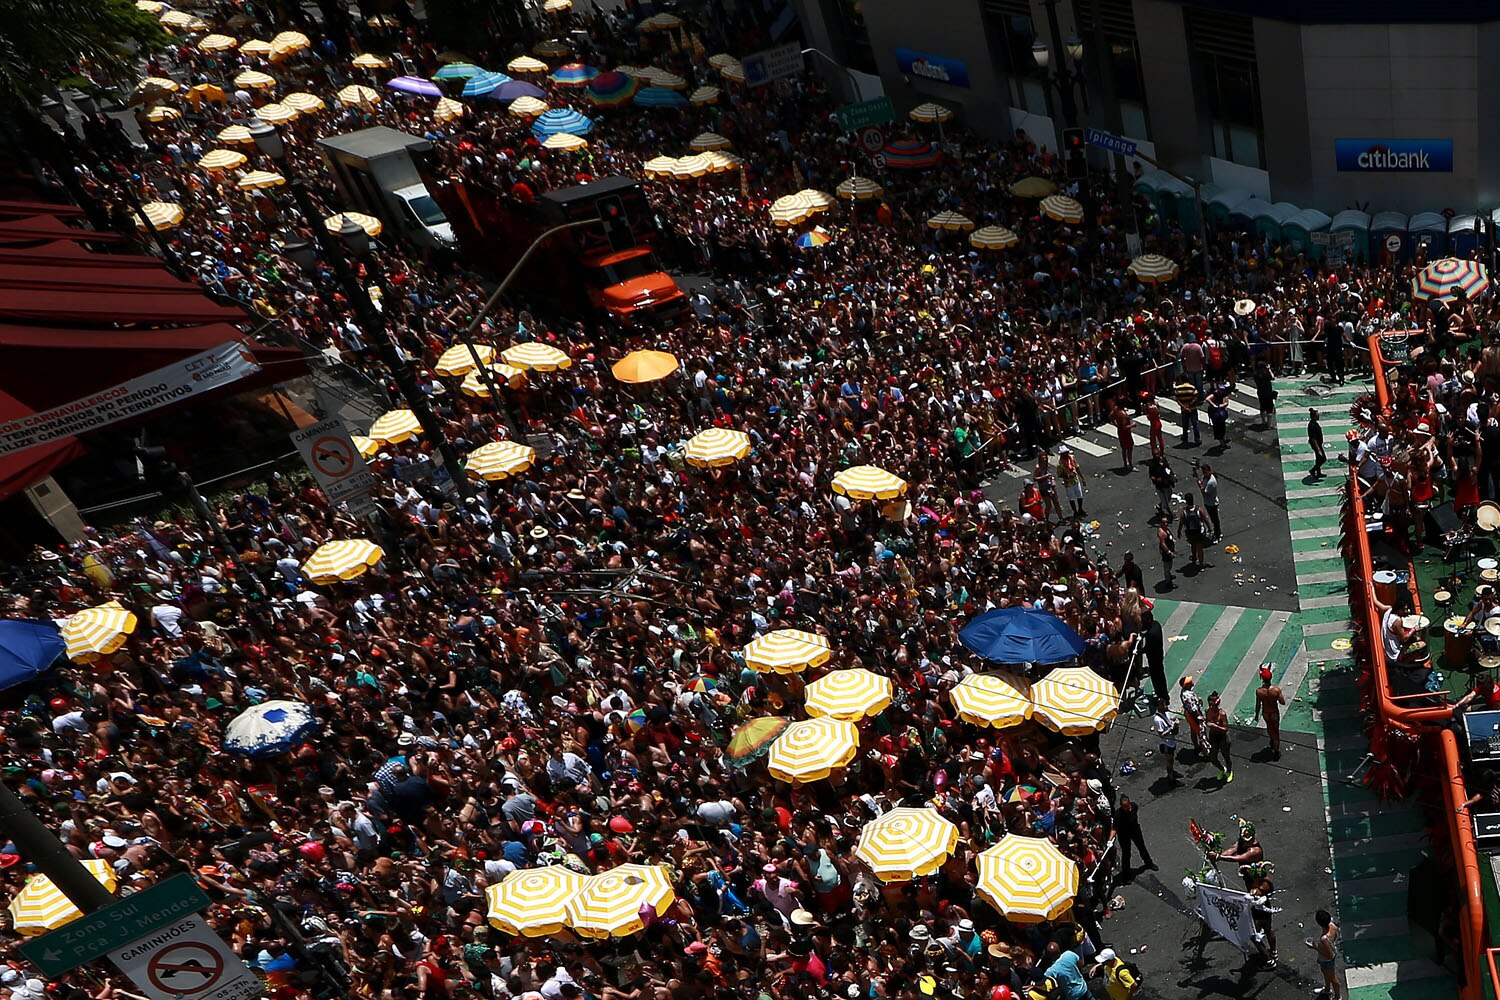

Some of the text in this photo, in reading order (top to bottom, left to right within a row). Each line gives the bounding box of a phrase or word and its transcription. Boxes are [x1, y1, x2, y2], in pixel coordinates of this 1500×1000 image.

[866, 132, 880, 144] 40
[1089, 129, 1133, 153] Ipiranga
[1357, 147, 1430, 168] citibank
[5, 383, 168, 442] TEMPORÁRIOS NO PERÍODO
[24, 386, 129, 427] CARNAVALESCOS
[38, 415, 105, 441] CAMINHOS
[107, 384, 193, 421] ALTERNATIVOS
[60, 903, 139, 944] Zona Sul
[136, 895, 200, 928] Mendes
